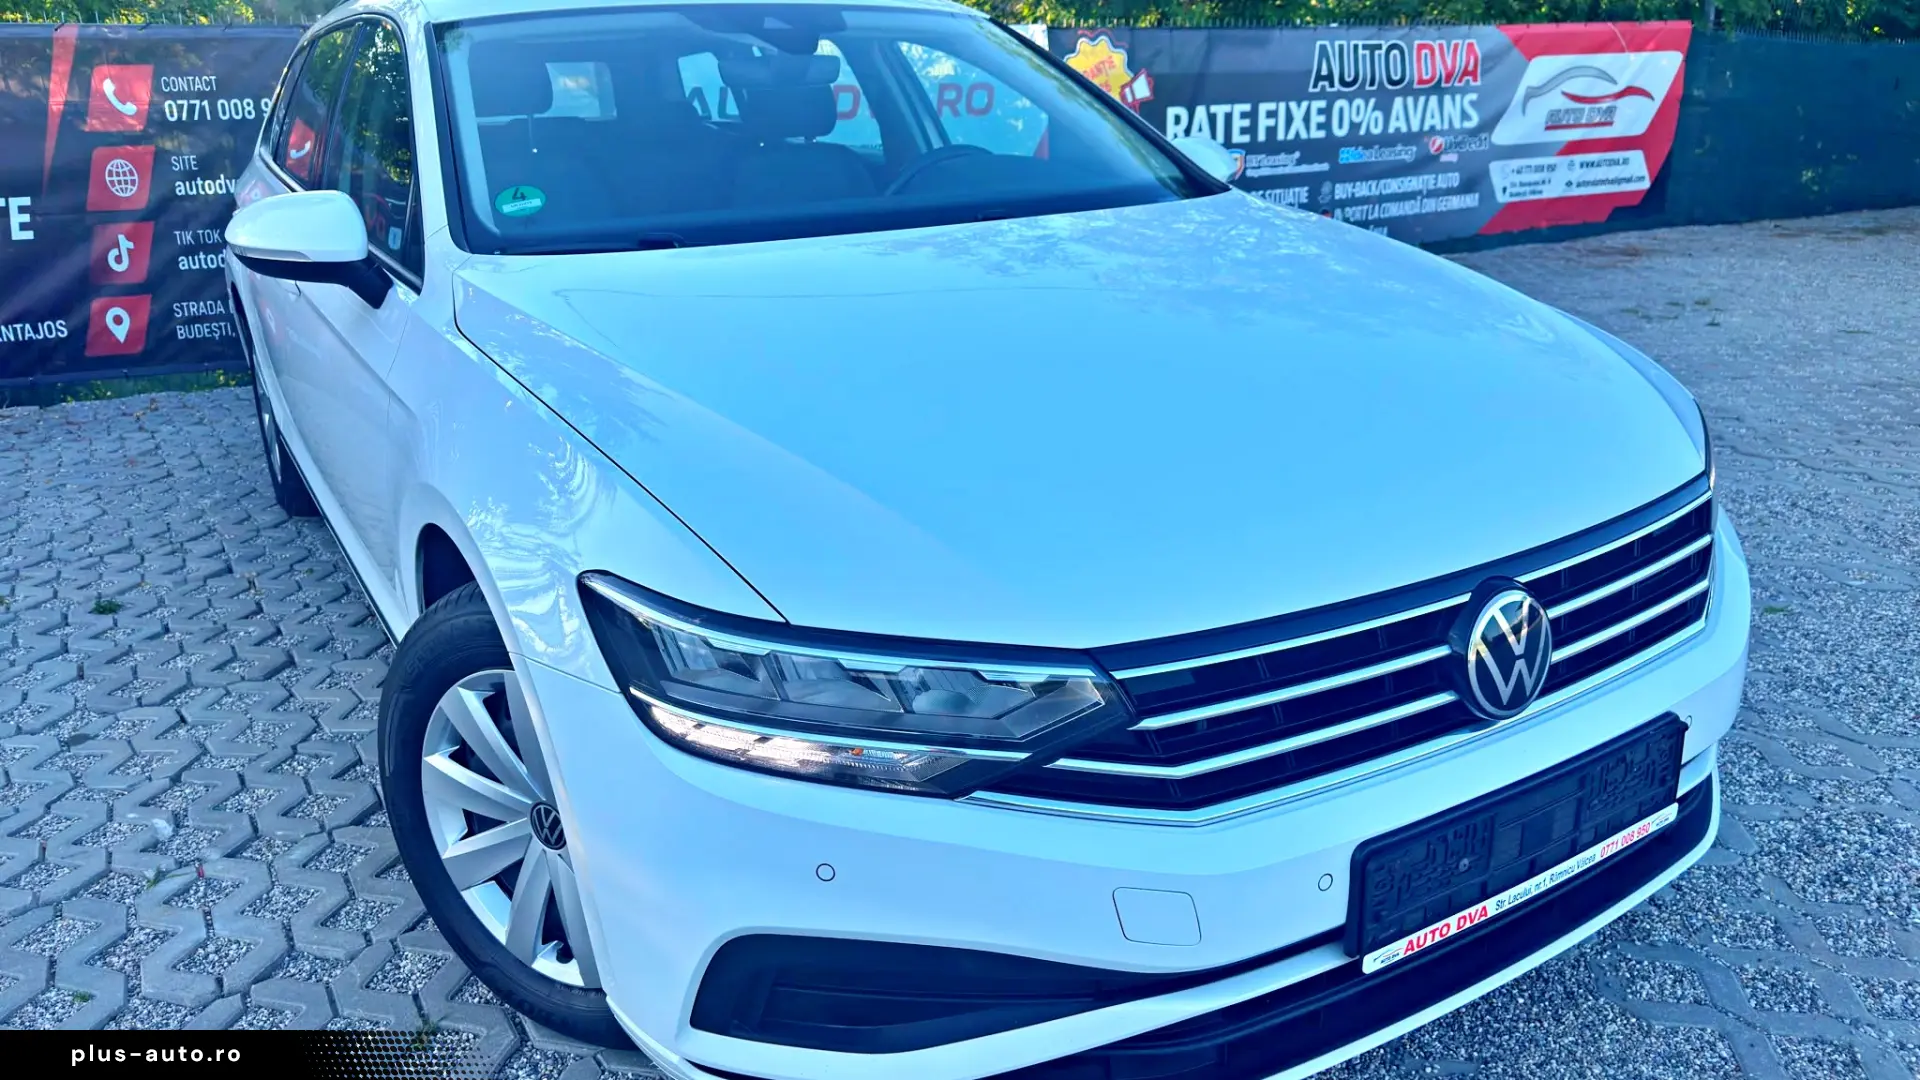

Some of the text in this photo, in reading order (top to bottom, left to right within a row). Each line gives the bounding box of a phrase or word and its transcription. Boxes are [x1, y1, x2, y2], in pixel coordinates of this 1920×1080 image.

[1308, 39, 1482, 92] AUTO DVA
[161, 75, 217, 92] CONTACT
[164, 99, 212, 122] 0771
[217, 98, 256, 121] 008
[1165, 92, 1480, 146] RATE FIXE 0% AVANS
[171, 154, 199, 171] SITE
[174, 173, 236, 196] autodv
[1437, 172, 1461, 190] AUTO
[511, 187, 527, 200] 4
[1368, 203, 1379, 220] LA
[1437, 192, 1480, 212] GERMANIA
[173, 228, 222, 245] TIK TOK
[178, 248, 226, 270] autod
[173, 300, 226, 318] STRADA
[1473, 593, 1550, 712] VW
[1403, 922, 1452, 956] AUTO
[1456, 904, 1489, 931] DVA
[1495, 899, 1507, 911] Str.
[1600, 839, 1619, 858] 0771
[1621, 830, 1636, 847] 008
[1636, 821, 1651, 839] 950
